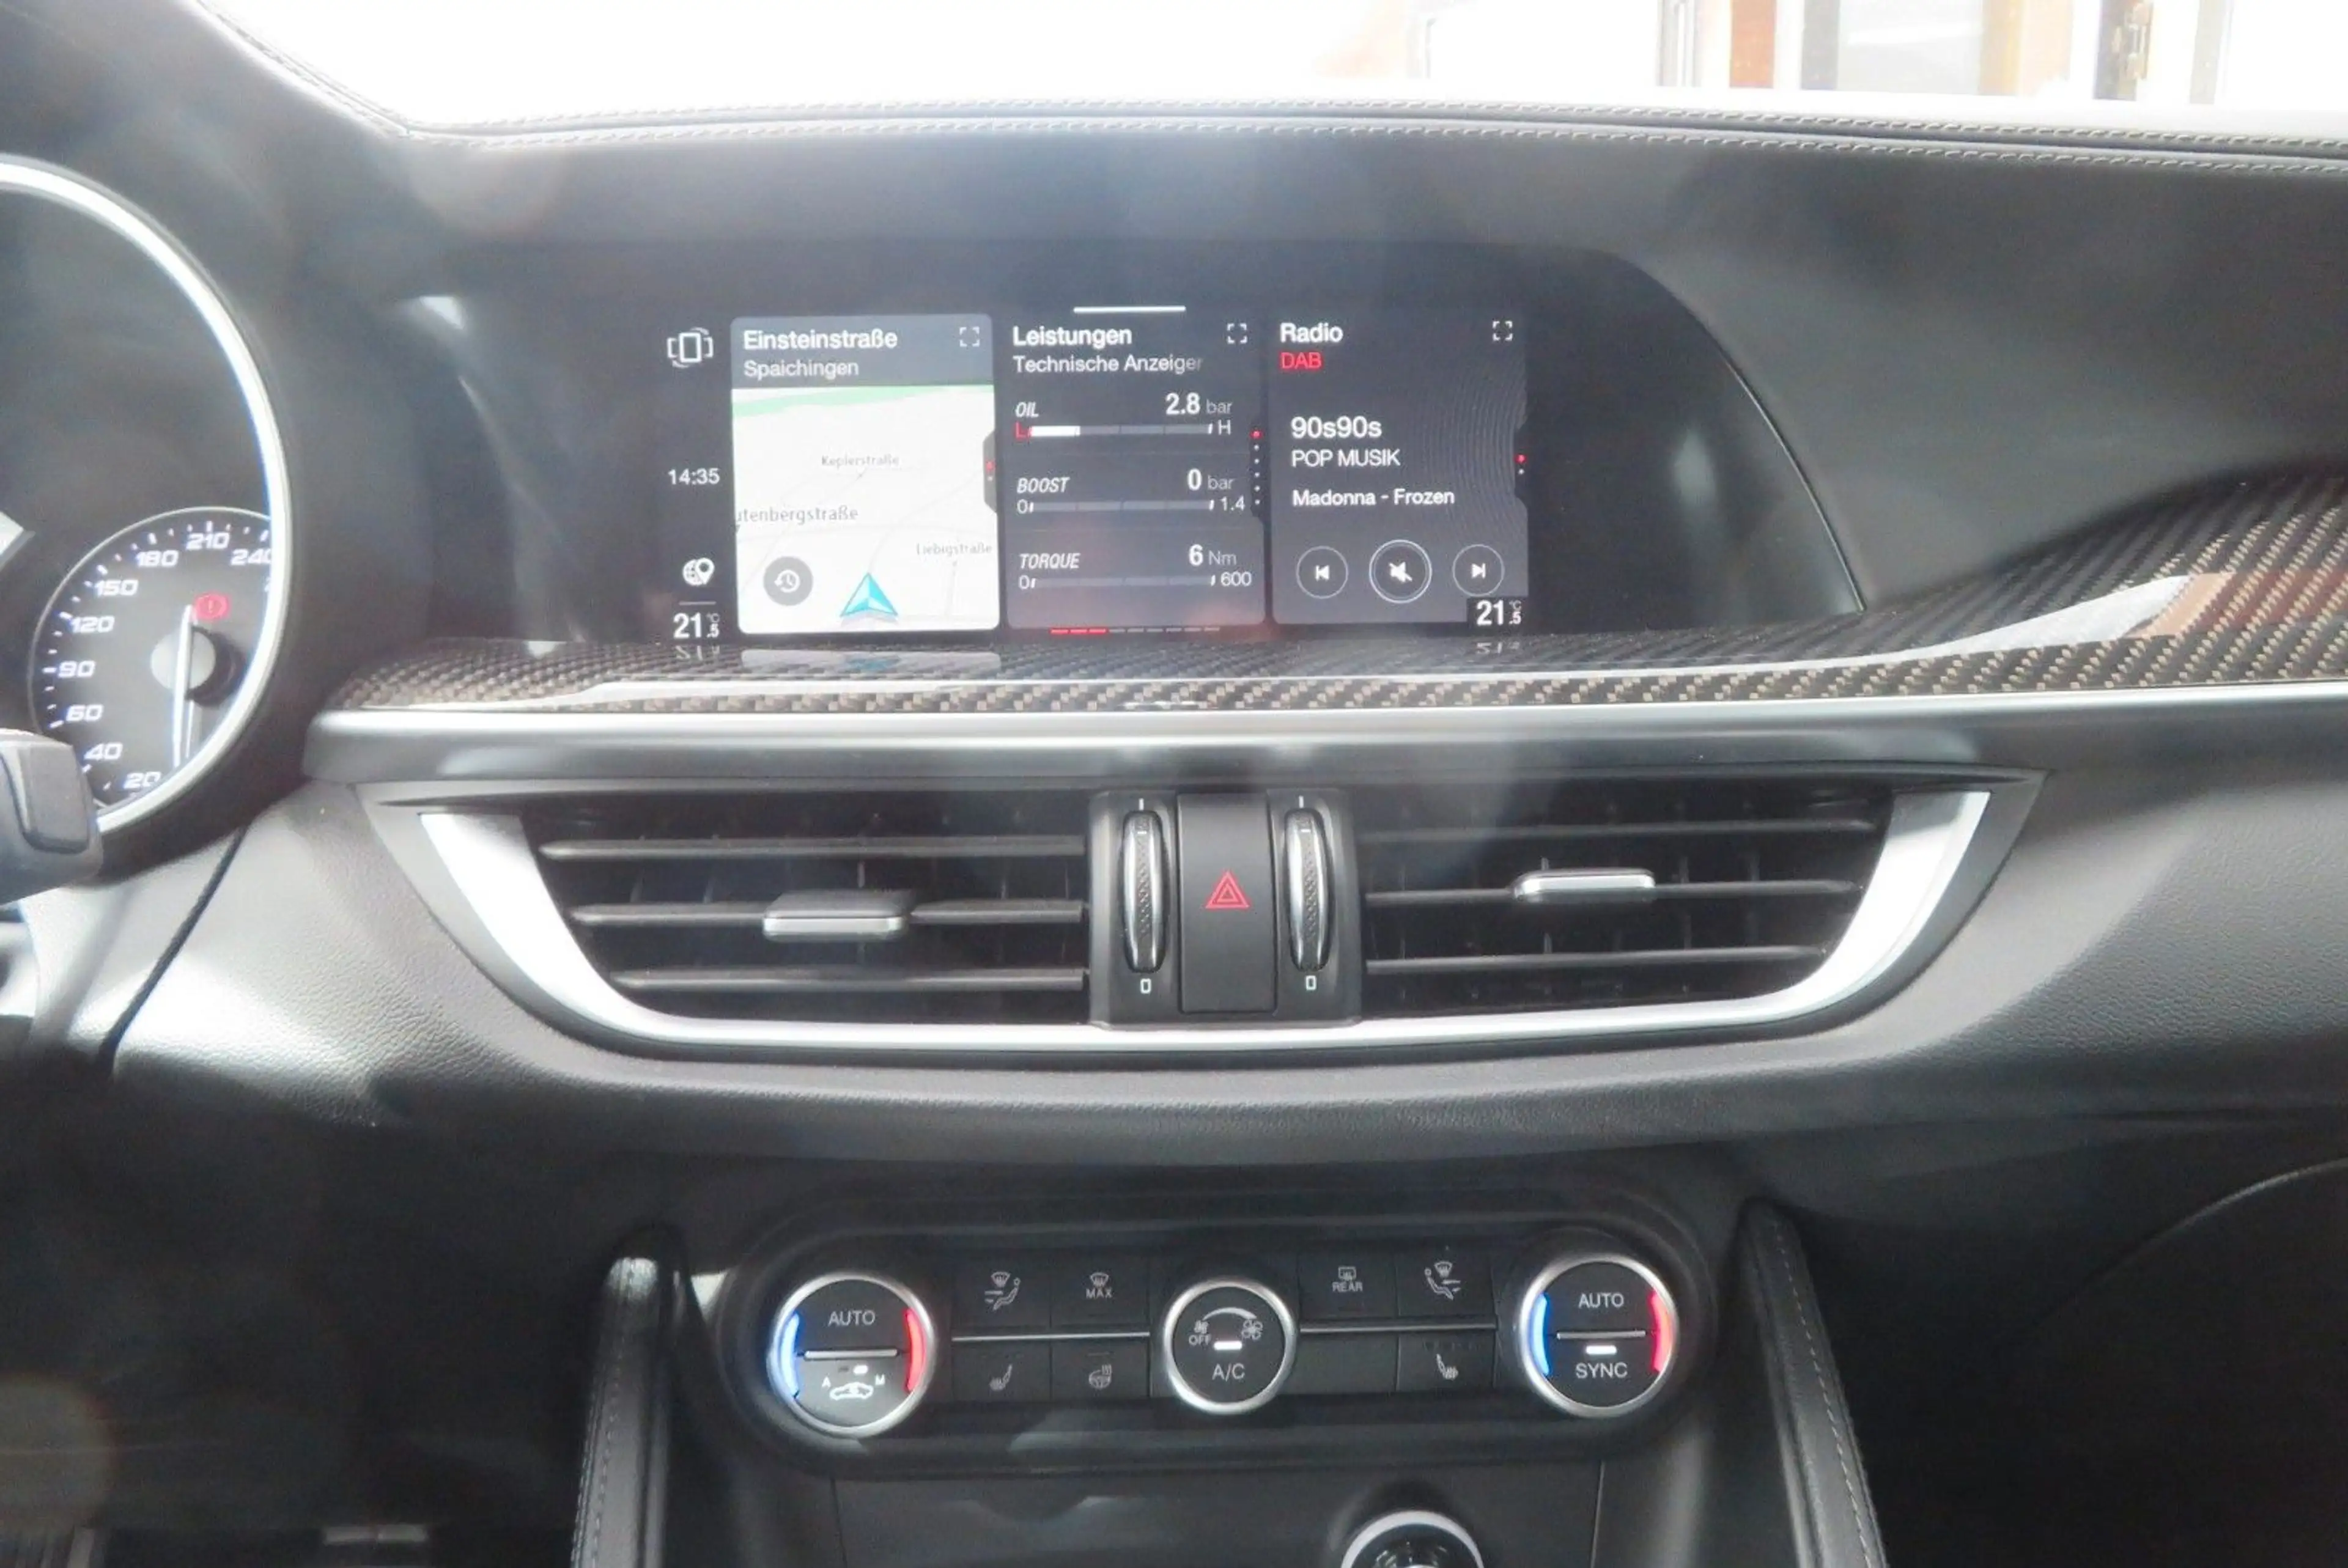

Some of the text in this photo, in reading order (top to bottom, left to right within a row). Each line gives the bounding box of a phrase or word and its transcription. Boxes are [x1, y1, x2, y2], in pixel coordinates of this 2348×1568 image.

[744, 328, 898, 352] Einsteinstraße
[1013, 325, 1132, 348] Leistungen
[1280, 322, 1344, 344] Radio
[744, 359, 859, 380] Spaichingen
[1013, 355, 1119, 374] Technische
[1280, 352, 1322, 370] DAB
[1016, 402, 1039, 418] OIL
[1165, 392, 1233, 415] 2.8 bar
[1218, 420, 1231, 435] H
[1291, 416, 1383, 438] 90s90s
[1291, 449, 1401, 468] POP MUSIK
[668, 469, 720, 485] 14:35
[1017, 476, 1070, 494] BOOST
[1187, 469, 1234, 491] 0 bar
[1220, 496, 1246, 511] 1.4
[1293, 490, 1376, 506] Madonna
[1394, 488, 1455, 506] Frozen
[186, 532, 230, 549] 210
[136, 550, 179, 568] 180
[1020, 553, 1080, 570] TORQUE
[1189, 544, 1237, 566] 6 Nm
[1220, 571, 1252, 586] 600
[95, 580, 138, 597] 150
[70, 616, 114, 633] 120
[58, 661, 95, 677] 90
[66, 704, 102, 722] 60
[84, 743, 122, 760] 40
[124, 771, 161, 789] 20
[1086, 1289, 1112, 1299] MAX
[1332, 1281, 1364, 1293] REAR
[1578, 1292, 1625, 1308] AUTO
[829, 1310, 876, 1327] AUTO
[1189, 1334, 1211, 1345] OFF
[1211, 1362, 1246, 1382] A/C
[1575, 1362, 1628, 1380] SYNC
[821, 1378, 832, 1388] A
[875, 1376, 886, 1386] M
